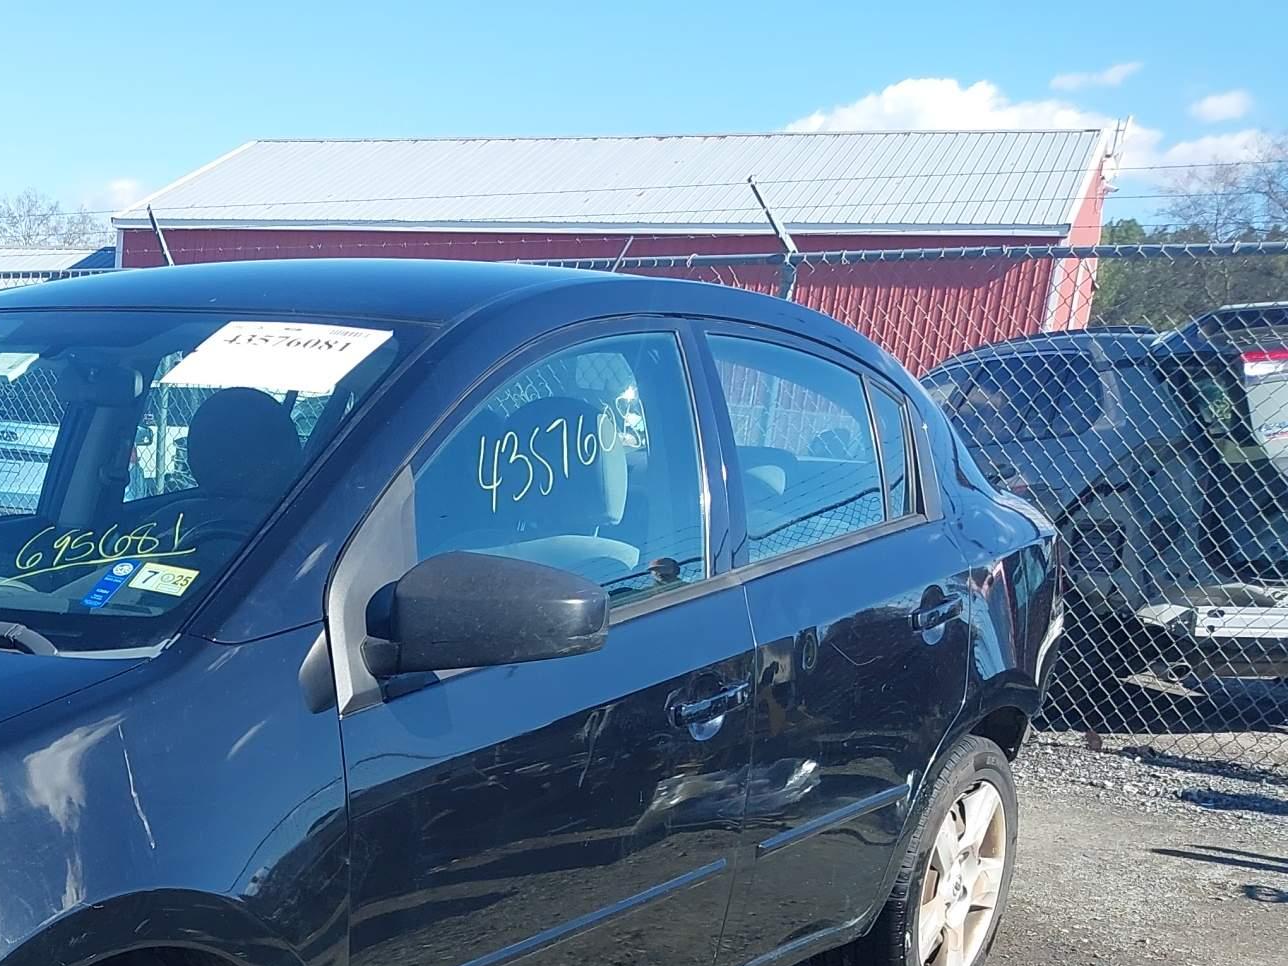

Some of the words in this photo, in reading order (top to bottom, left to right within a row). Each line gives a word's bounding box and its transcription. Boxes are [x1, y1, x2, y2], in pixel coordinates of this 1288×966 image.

[223, 333, 352, 352] 43576081
[15, 512, 185, 570] 695681
[141, 569, 159, 584] 7
[171, 574, 193, 587] 25
